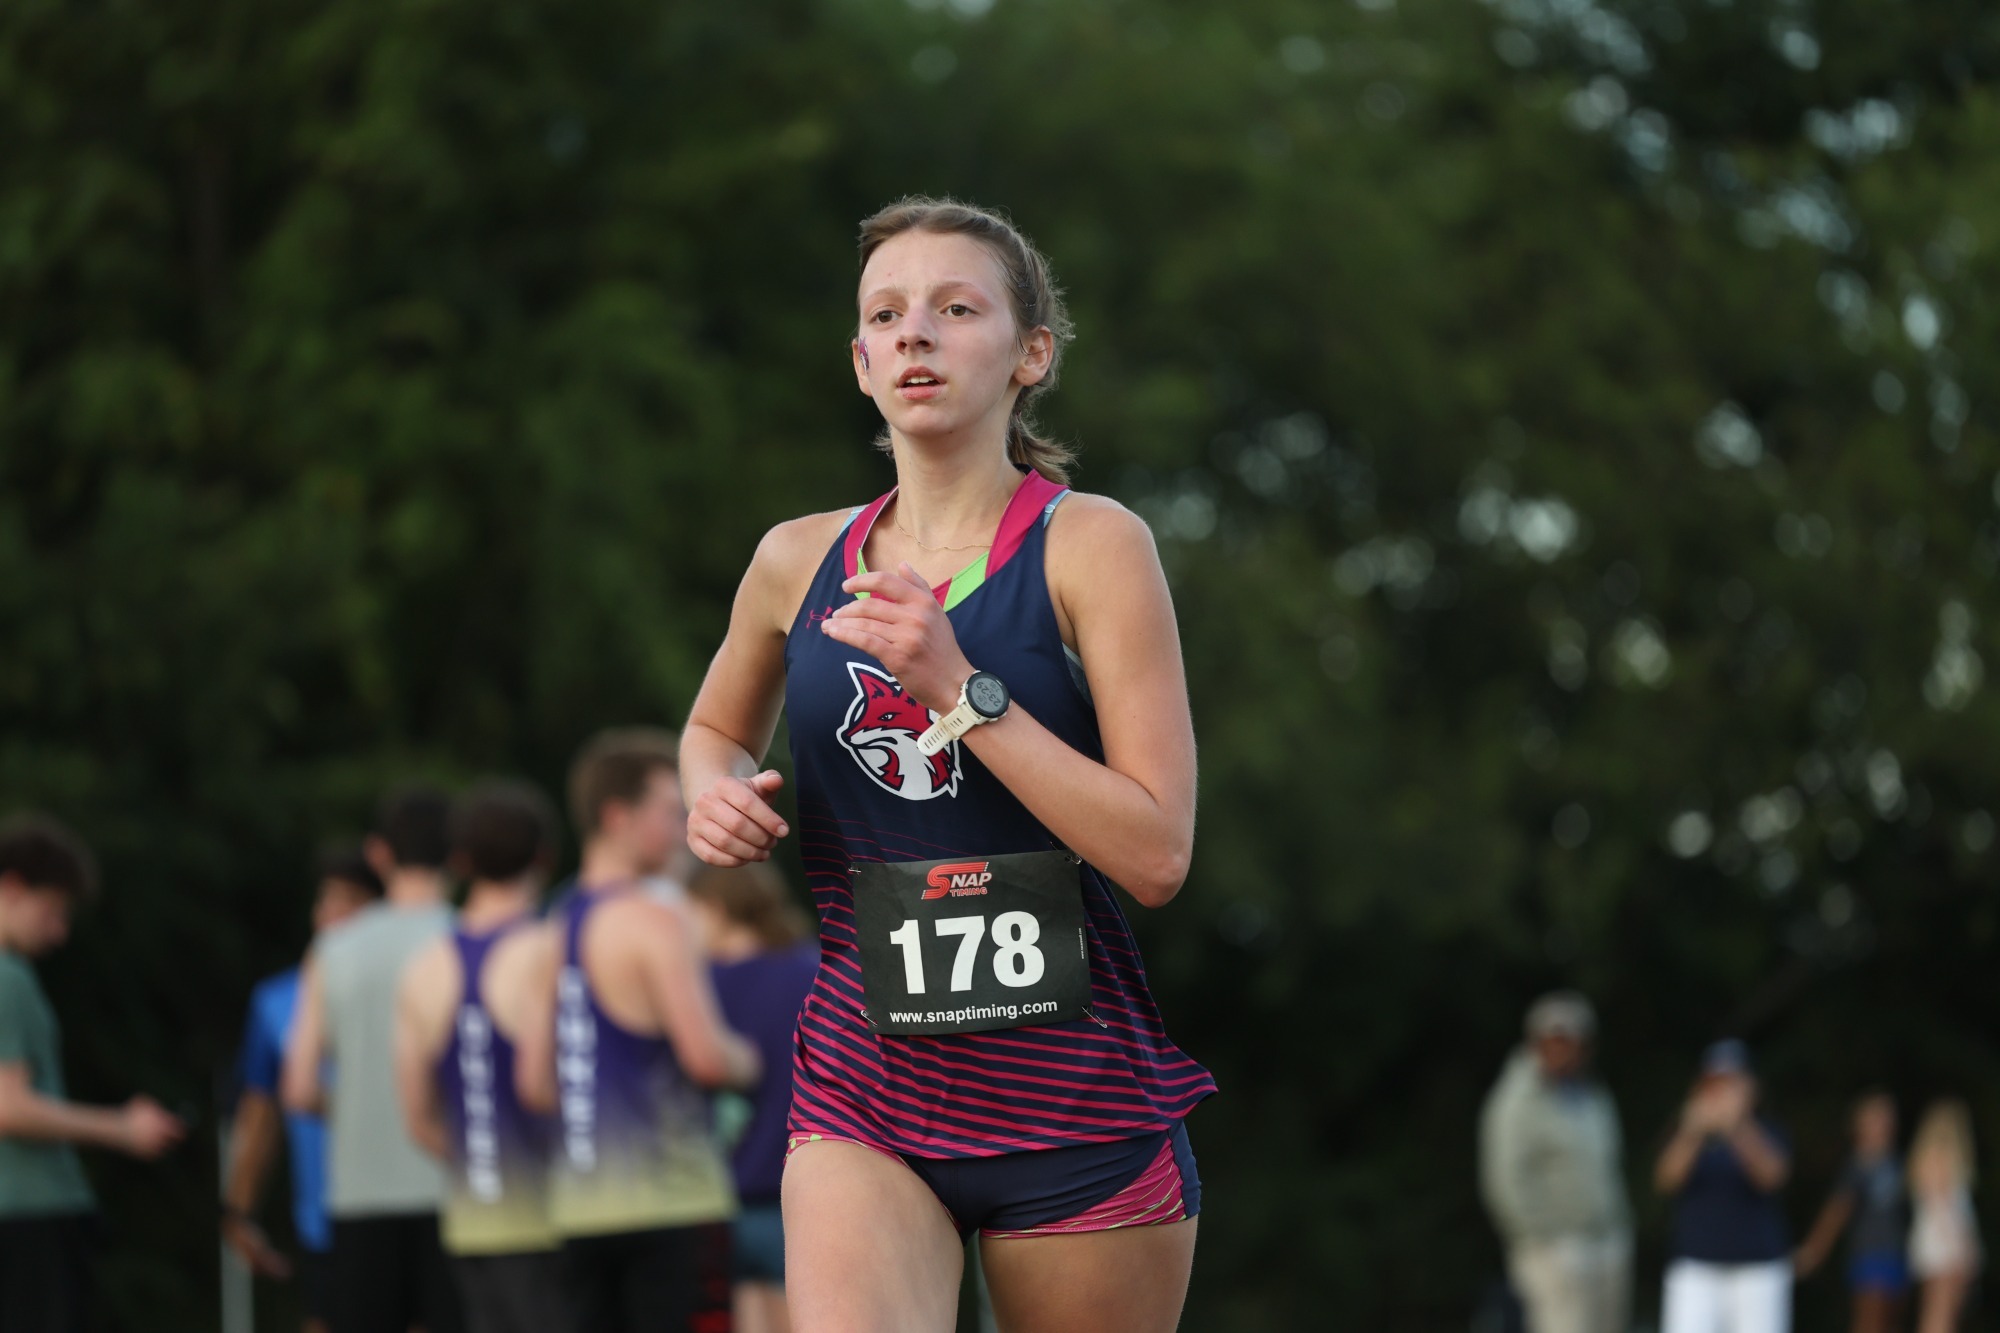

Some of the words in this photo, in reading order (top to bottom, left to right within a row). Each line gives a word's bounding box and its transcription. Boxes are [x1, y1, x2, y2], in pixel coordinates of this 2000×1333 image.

[976, 681, 1002, 707] 23:29
[921, 861, 992, 900] SNAP
[949, 887, 988, 898] TIMING
[889, 910, 1045, 995] 178
[889, 1001, 1058, 1024] www.snaptiming.com
